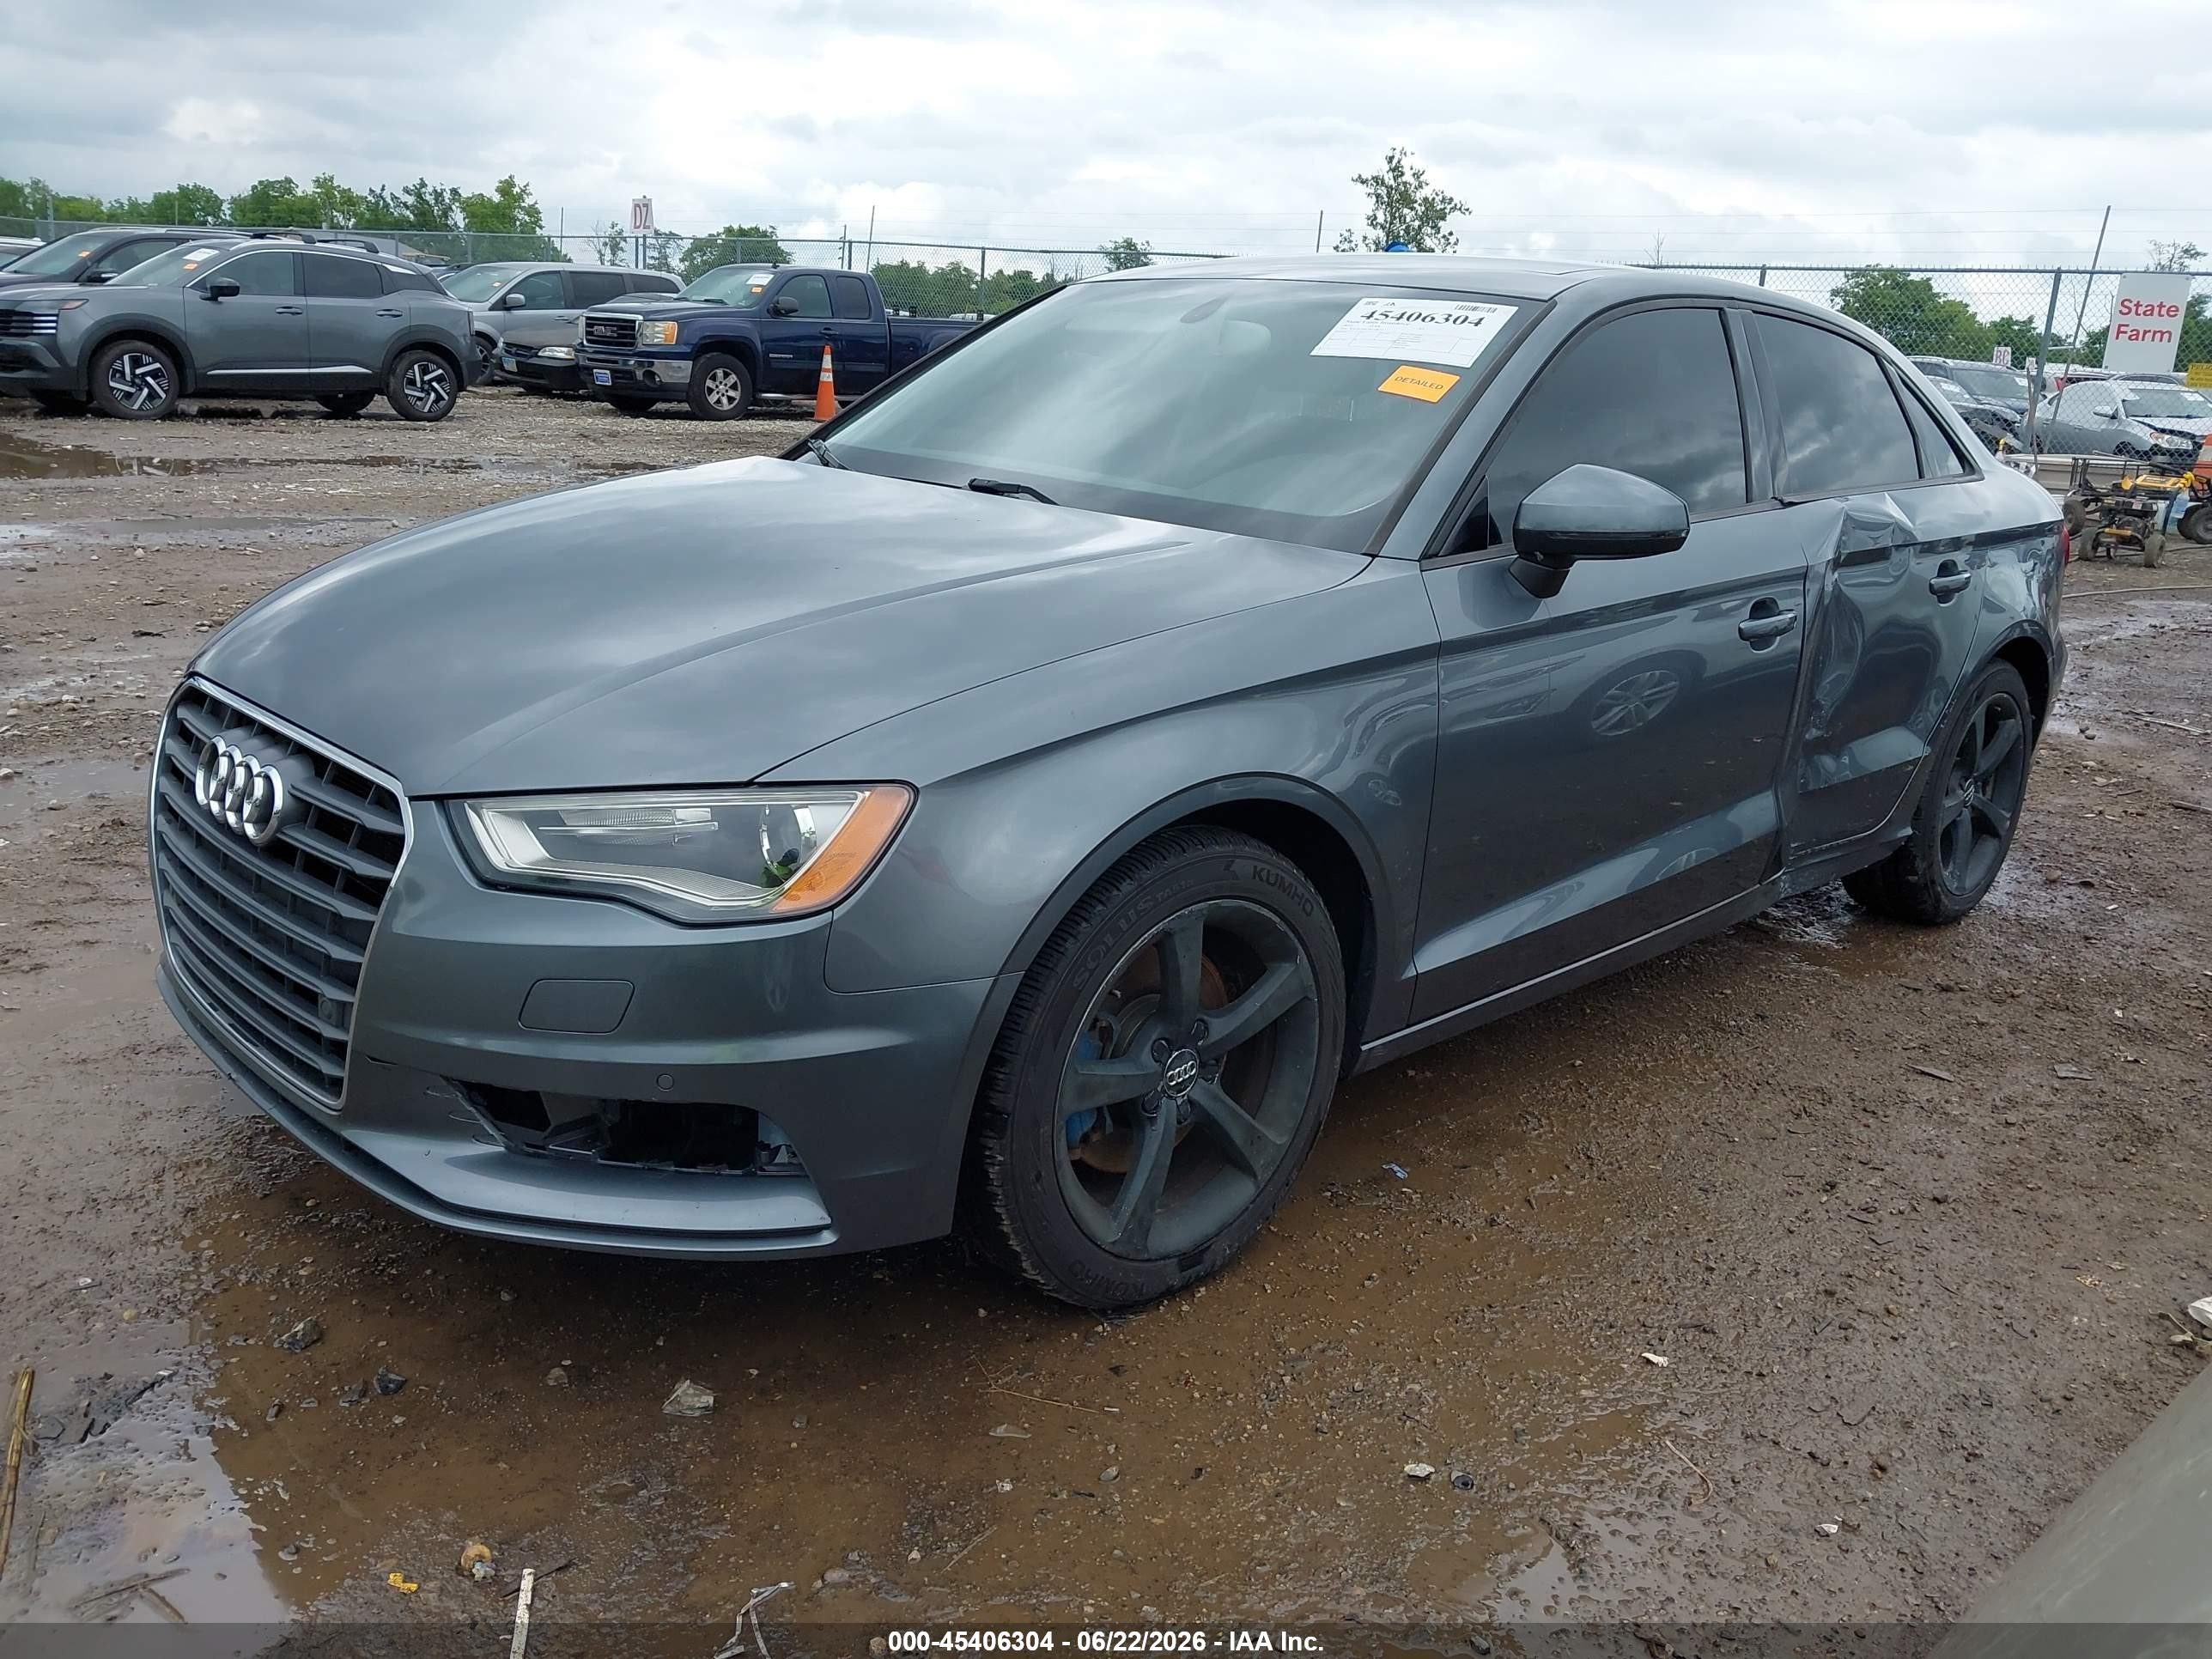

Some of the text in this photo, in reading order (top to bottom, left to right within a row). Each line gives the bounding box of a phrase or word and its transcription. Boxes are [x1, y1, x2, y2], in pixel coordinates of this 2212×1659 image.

[2118, 297, 2180, 318] State
[1361, 309, 1486, 328] 45406304
[2114, 323, 2173, 343] Farm
[1394, 374, 1444, 391] DETAILED
[1252, 865, 1314, 917] KUMHO
[1073, 895, 1153, 990] SOLUS
